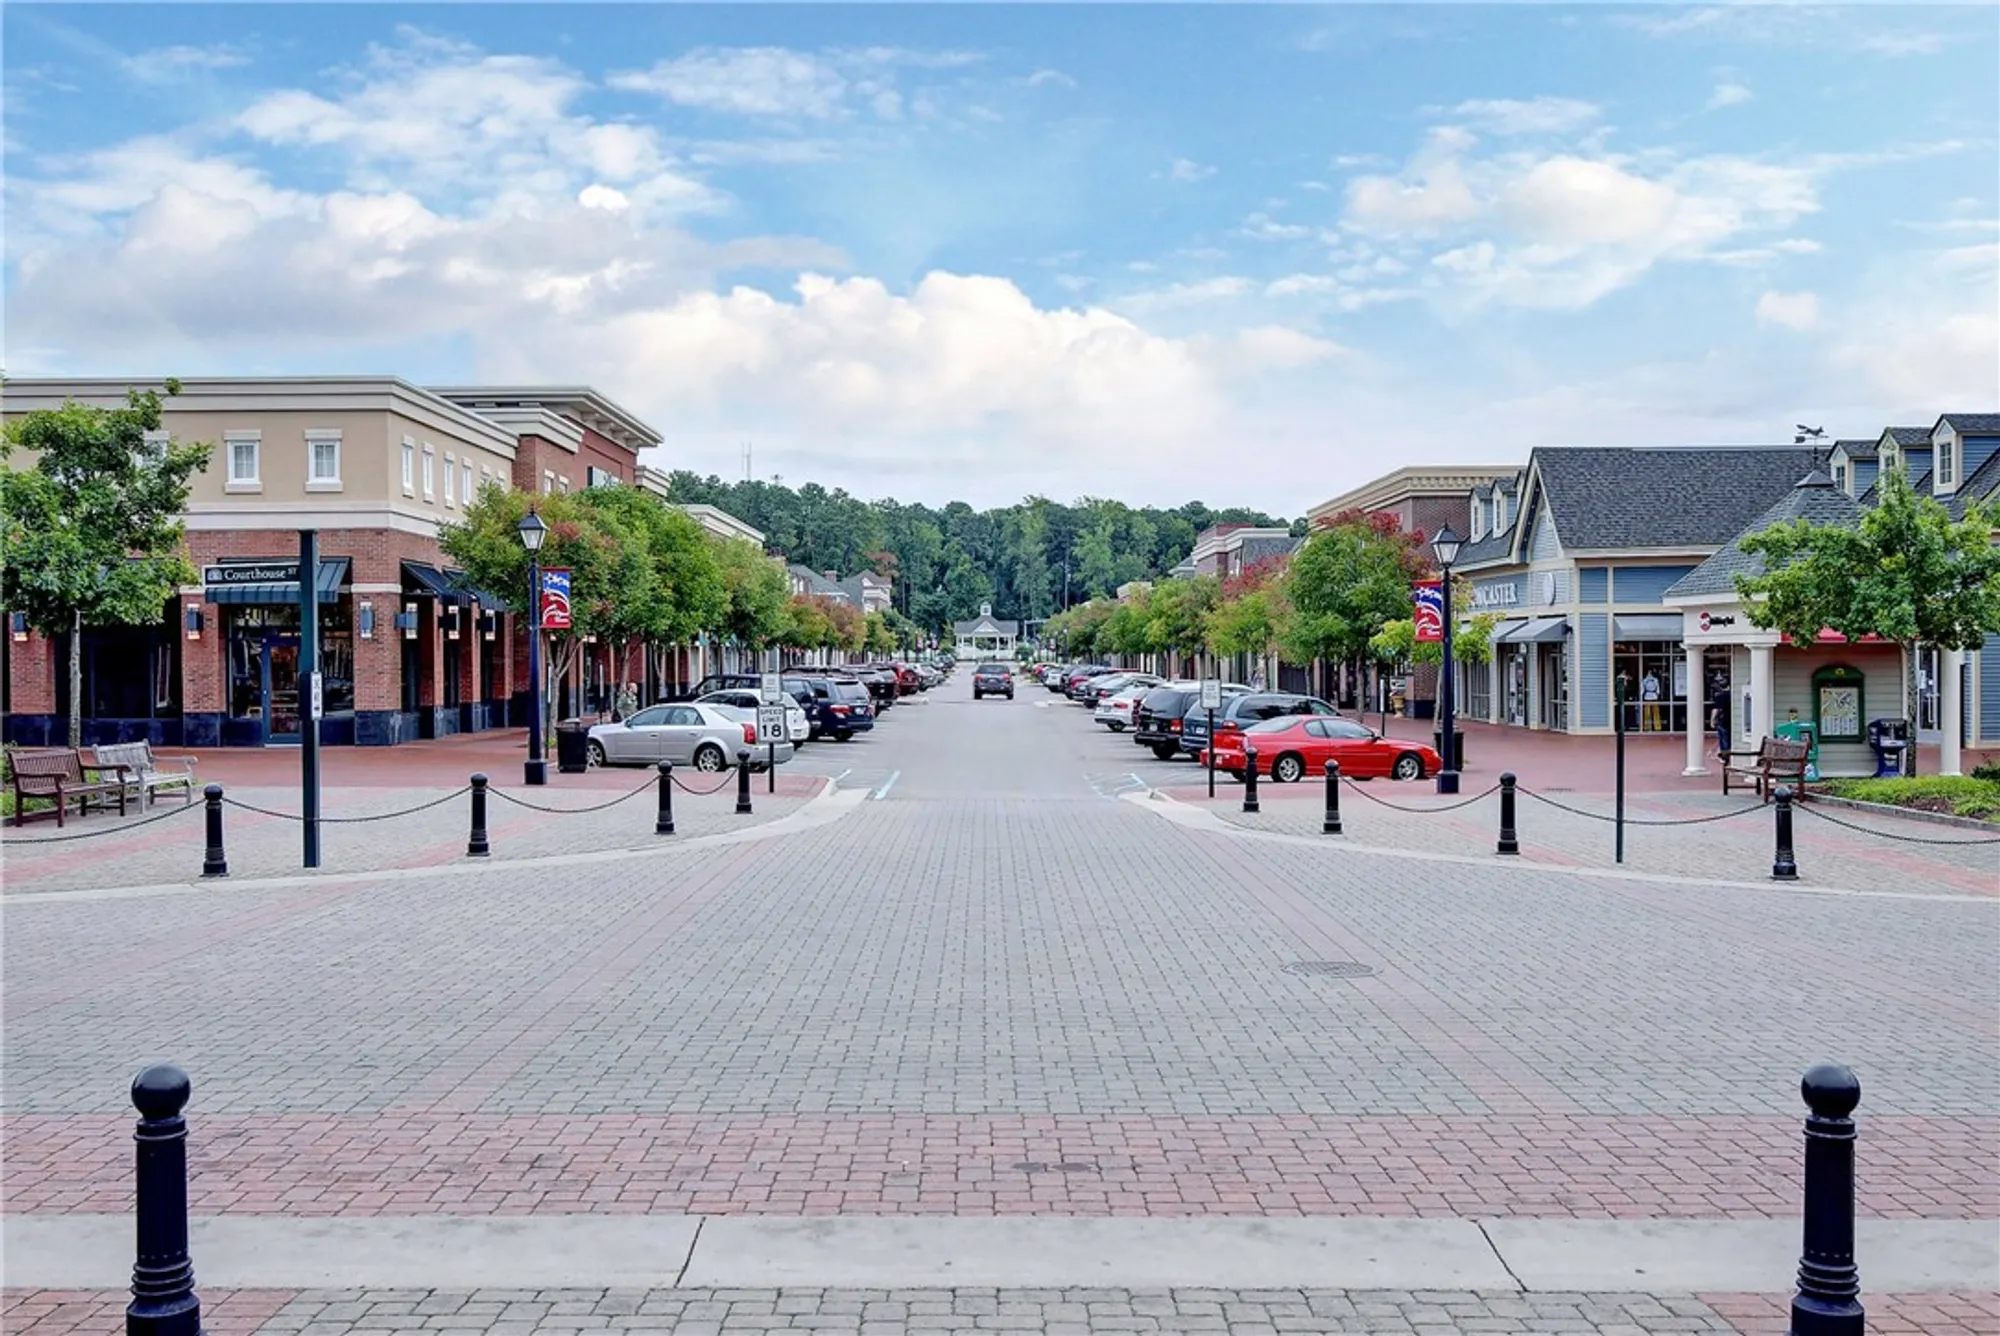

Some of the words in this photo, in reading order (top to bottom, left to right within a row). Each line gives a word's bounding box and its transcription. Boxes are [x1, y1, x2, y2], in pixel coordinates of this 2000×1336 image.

[223, 568, 287, 581] Courthouse
[760, 708, 783, 716] SPEED
[762, 723, 783, 738] 18
